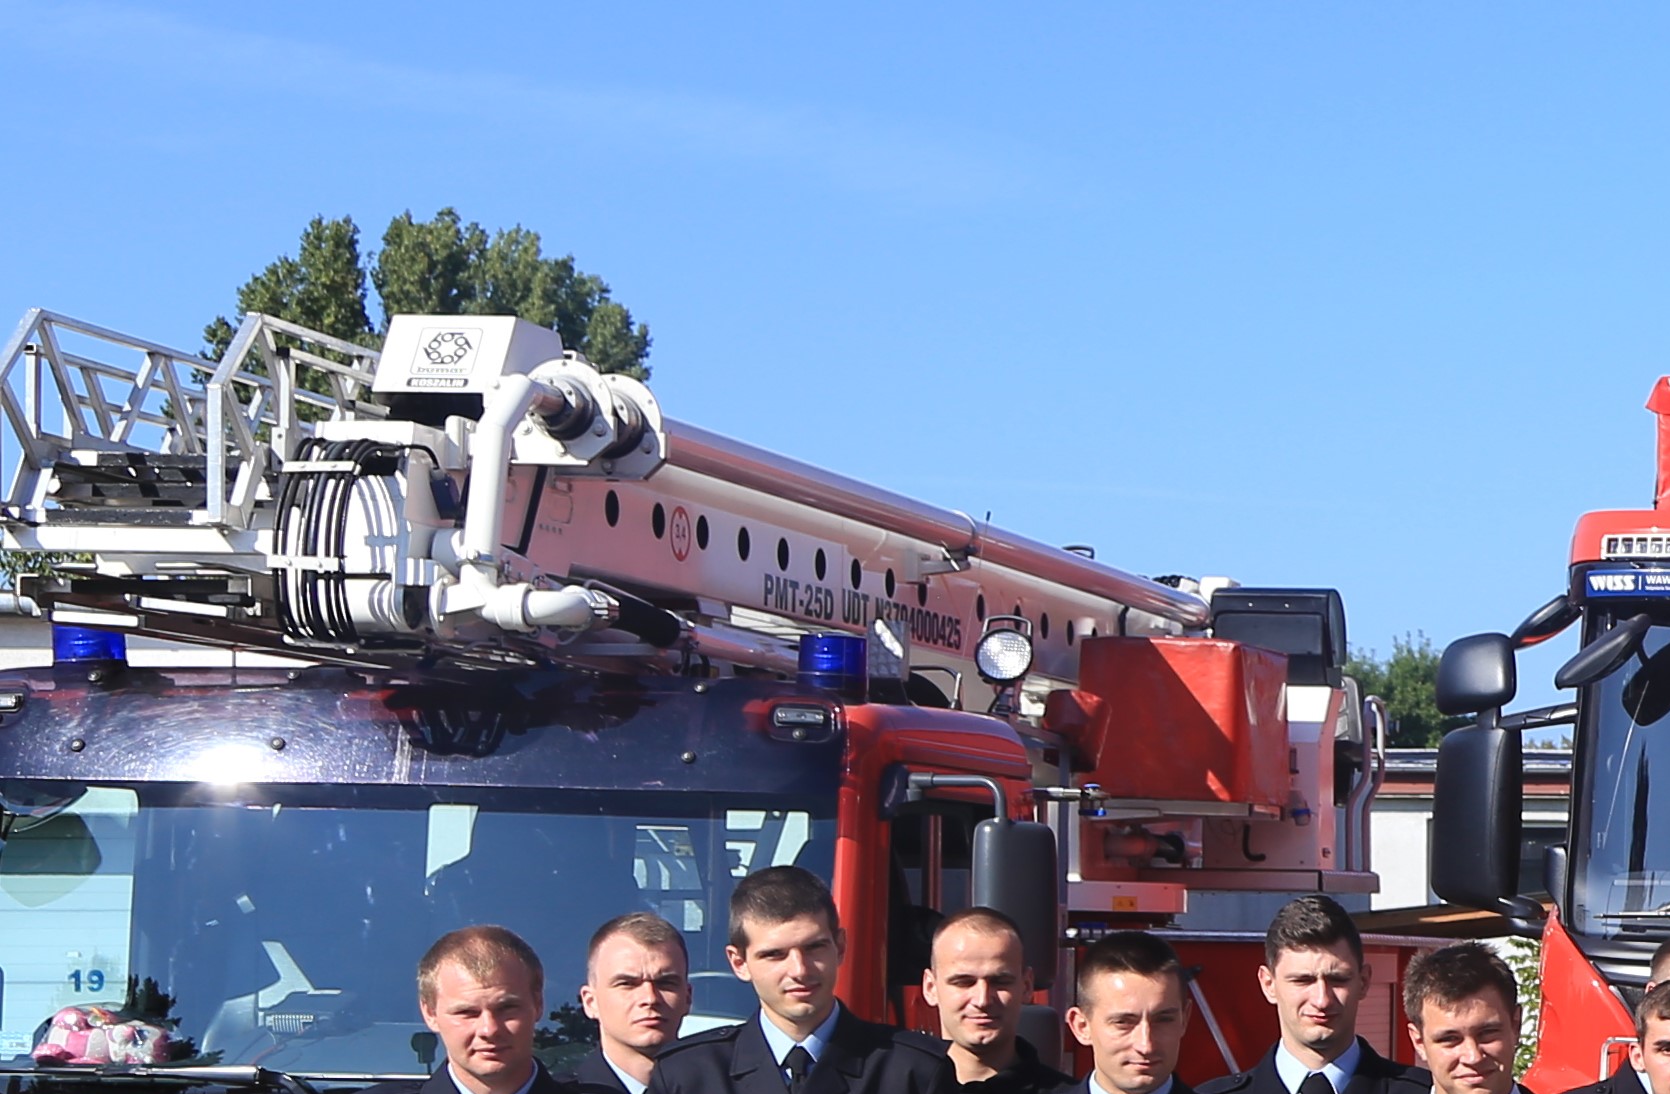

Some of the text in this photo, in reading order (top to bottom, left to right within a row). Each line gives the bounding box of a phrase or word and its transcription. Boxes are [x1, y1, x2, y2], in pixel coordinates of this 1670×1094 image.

[410, 379, 465, 387] KOSZALIN
[1589, 575, 1635, 591] WISS
[764, 574, 834, 621] PMT-25D
[842, 588, 869, 628] UDT
[68, 969, 105, 993] 19
